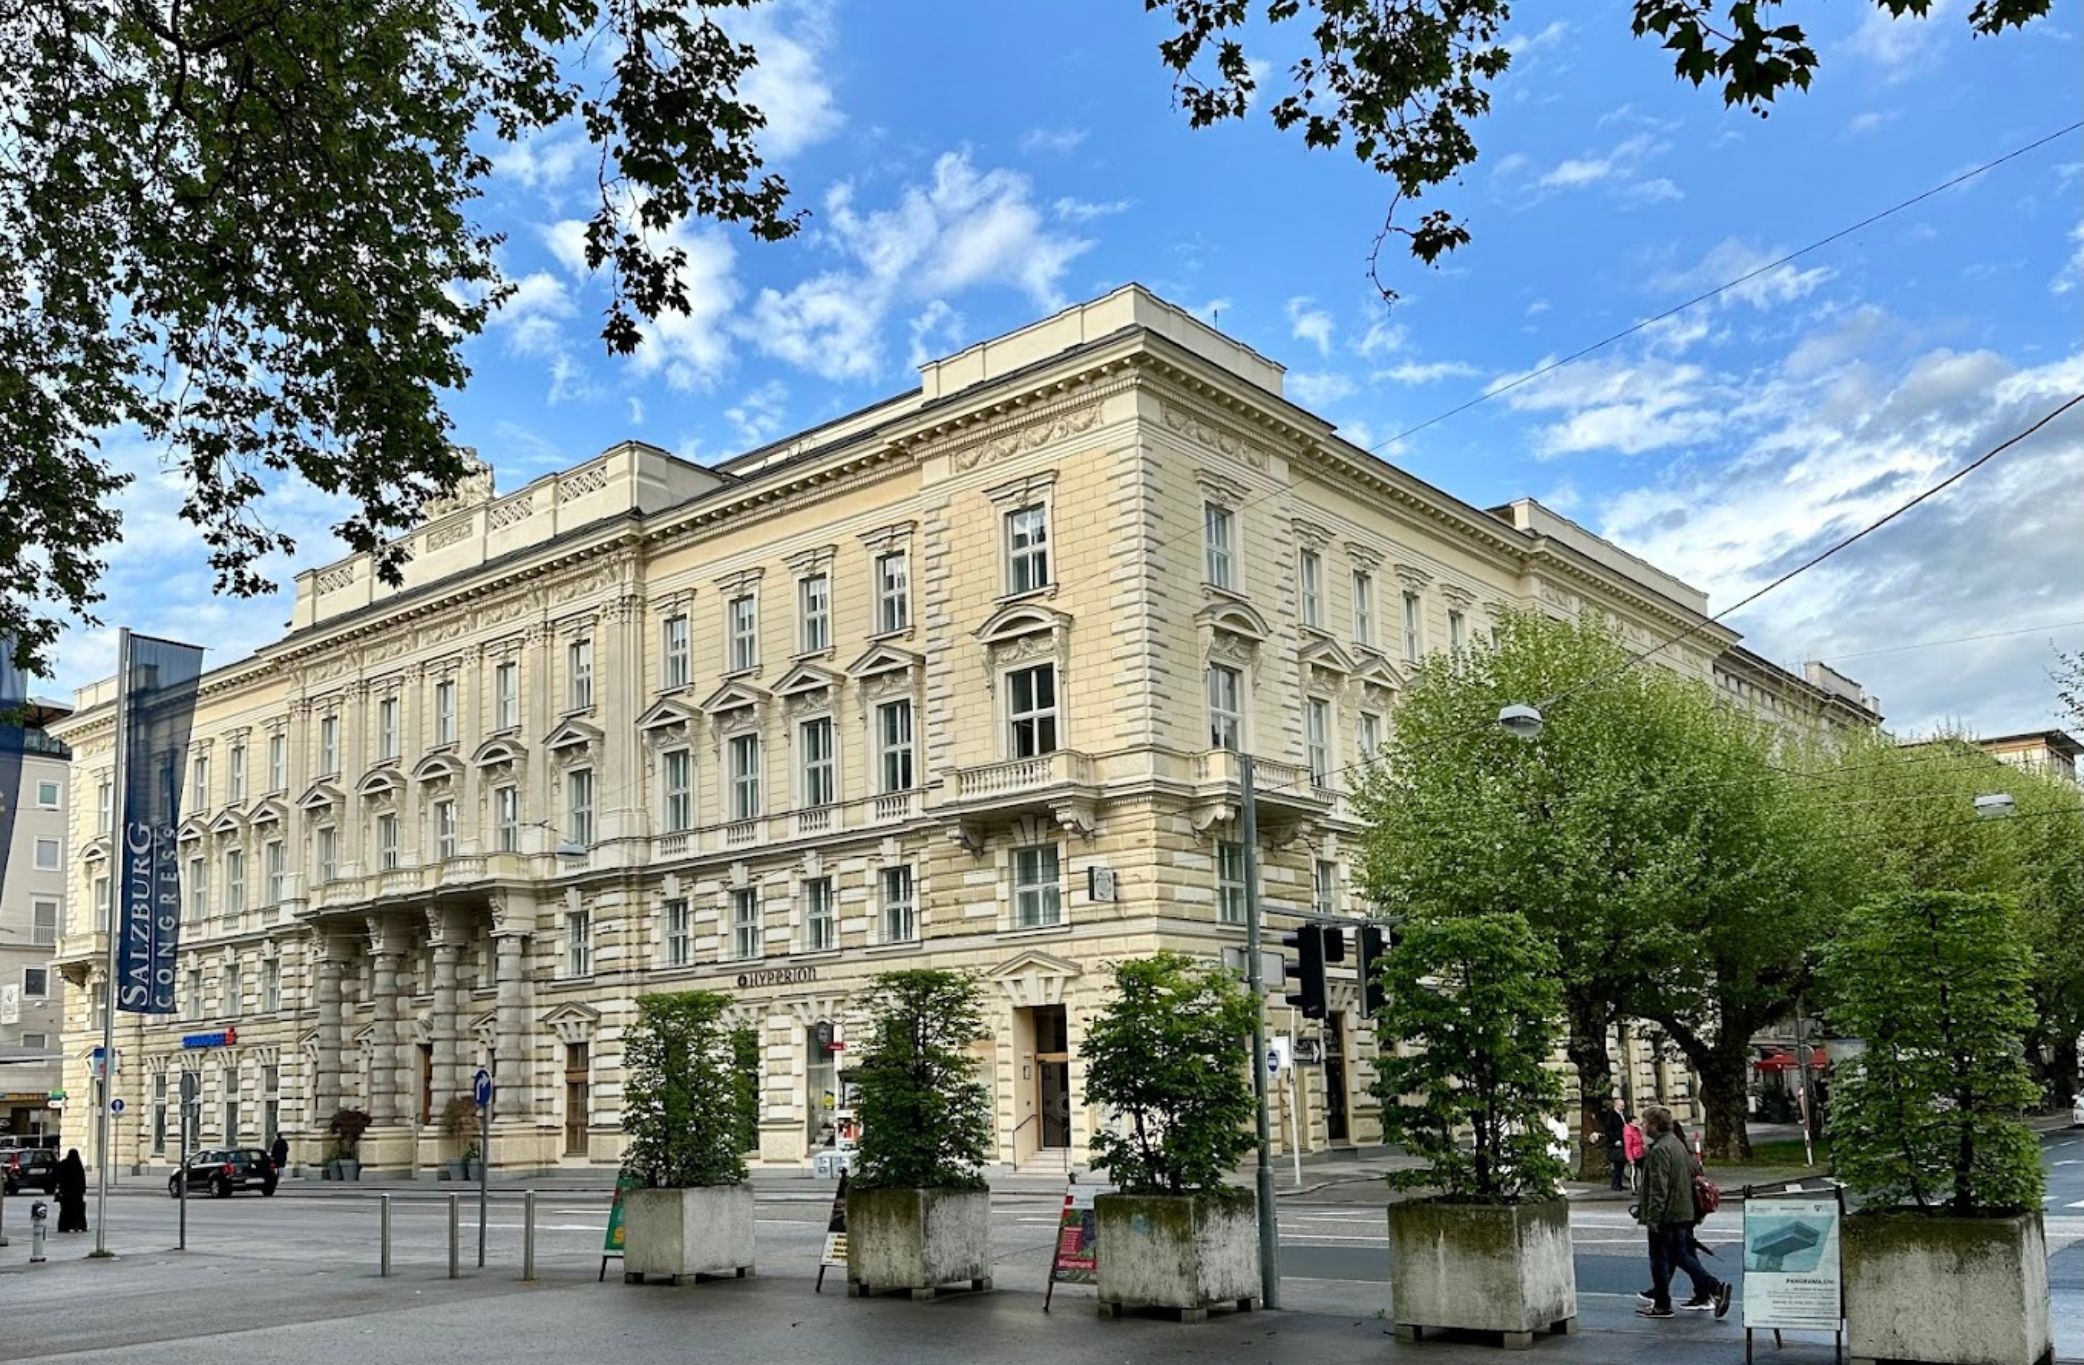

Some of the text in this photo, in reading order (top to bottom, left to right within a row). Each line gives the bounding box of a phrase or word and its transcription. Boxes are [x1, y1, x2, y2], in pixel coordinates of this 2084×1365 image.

[120, 821, 152, 1007] SALZBURG
[155, 827, 178, 1008] CONGRESS
[750, 967, 817, 987] HYPERION
